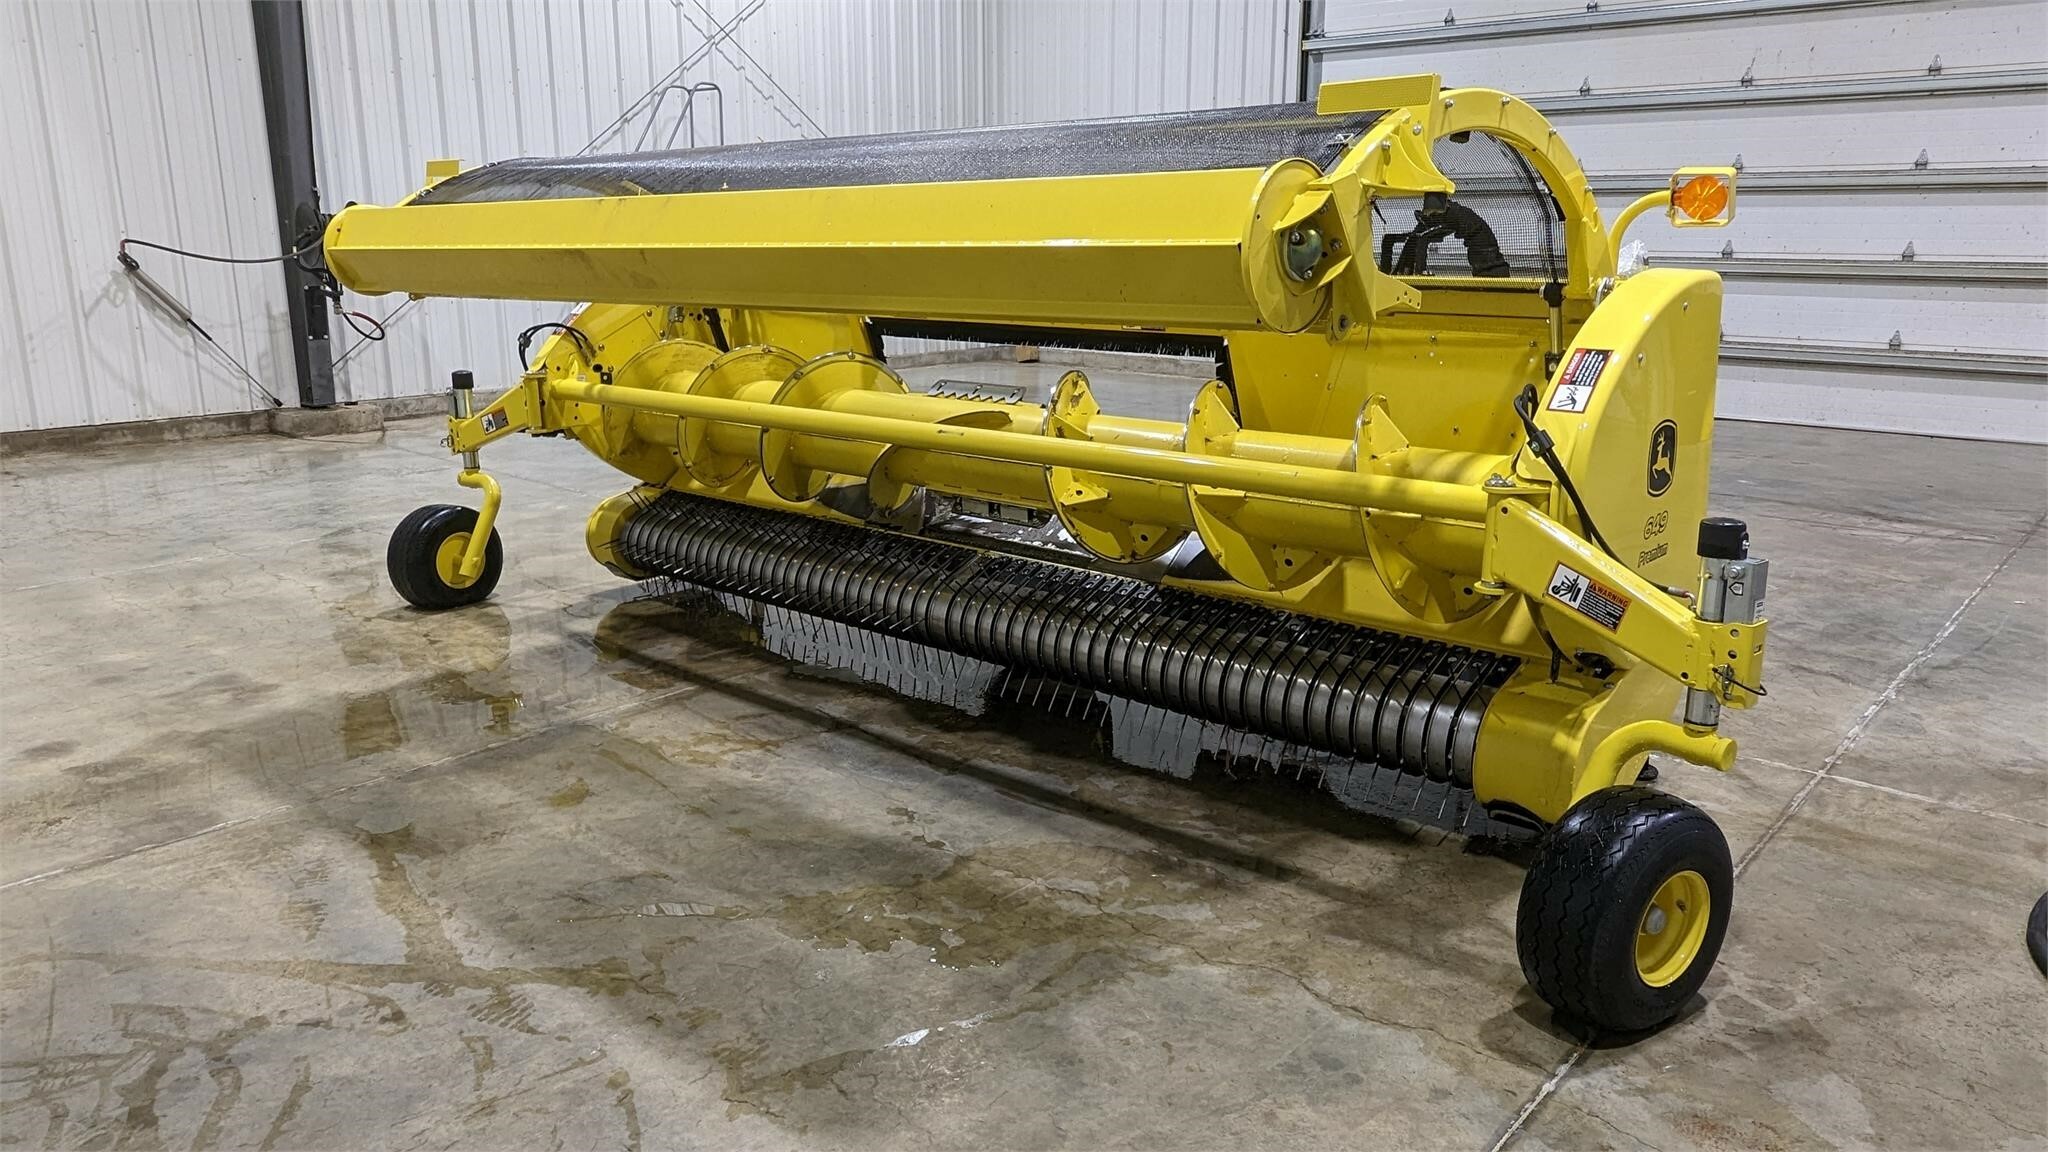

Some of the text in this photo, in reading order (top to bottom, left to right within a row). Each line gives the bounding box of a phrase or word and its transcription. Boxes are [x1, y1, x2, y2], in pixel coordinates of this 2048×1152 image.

[1643, 510, 1669, 540] 649
[1637, 543, 1669, 568] Premium
[1597, 586, 1629, 608] WARNING
